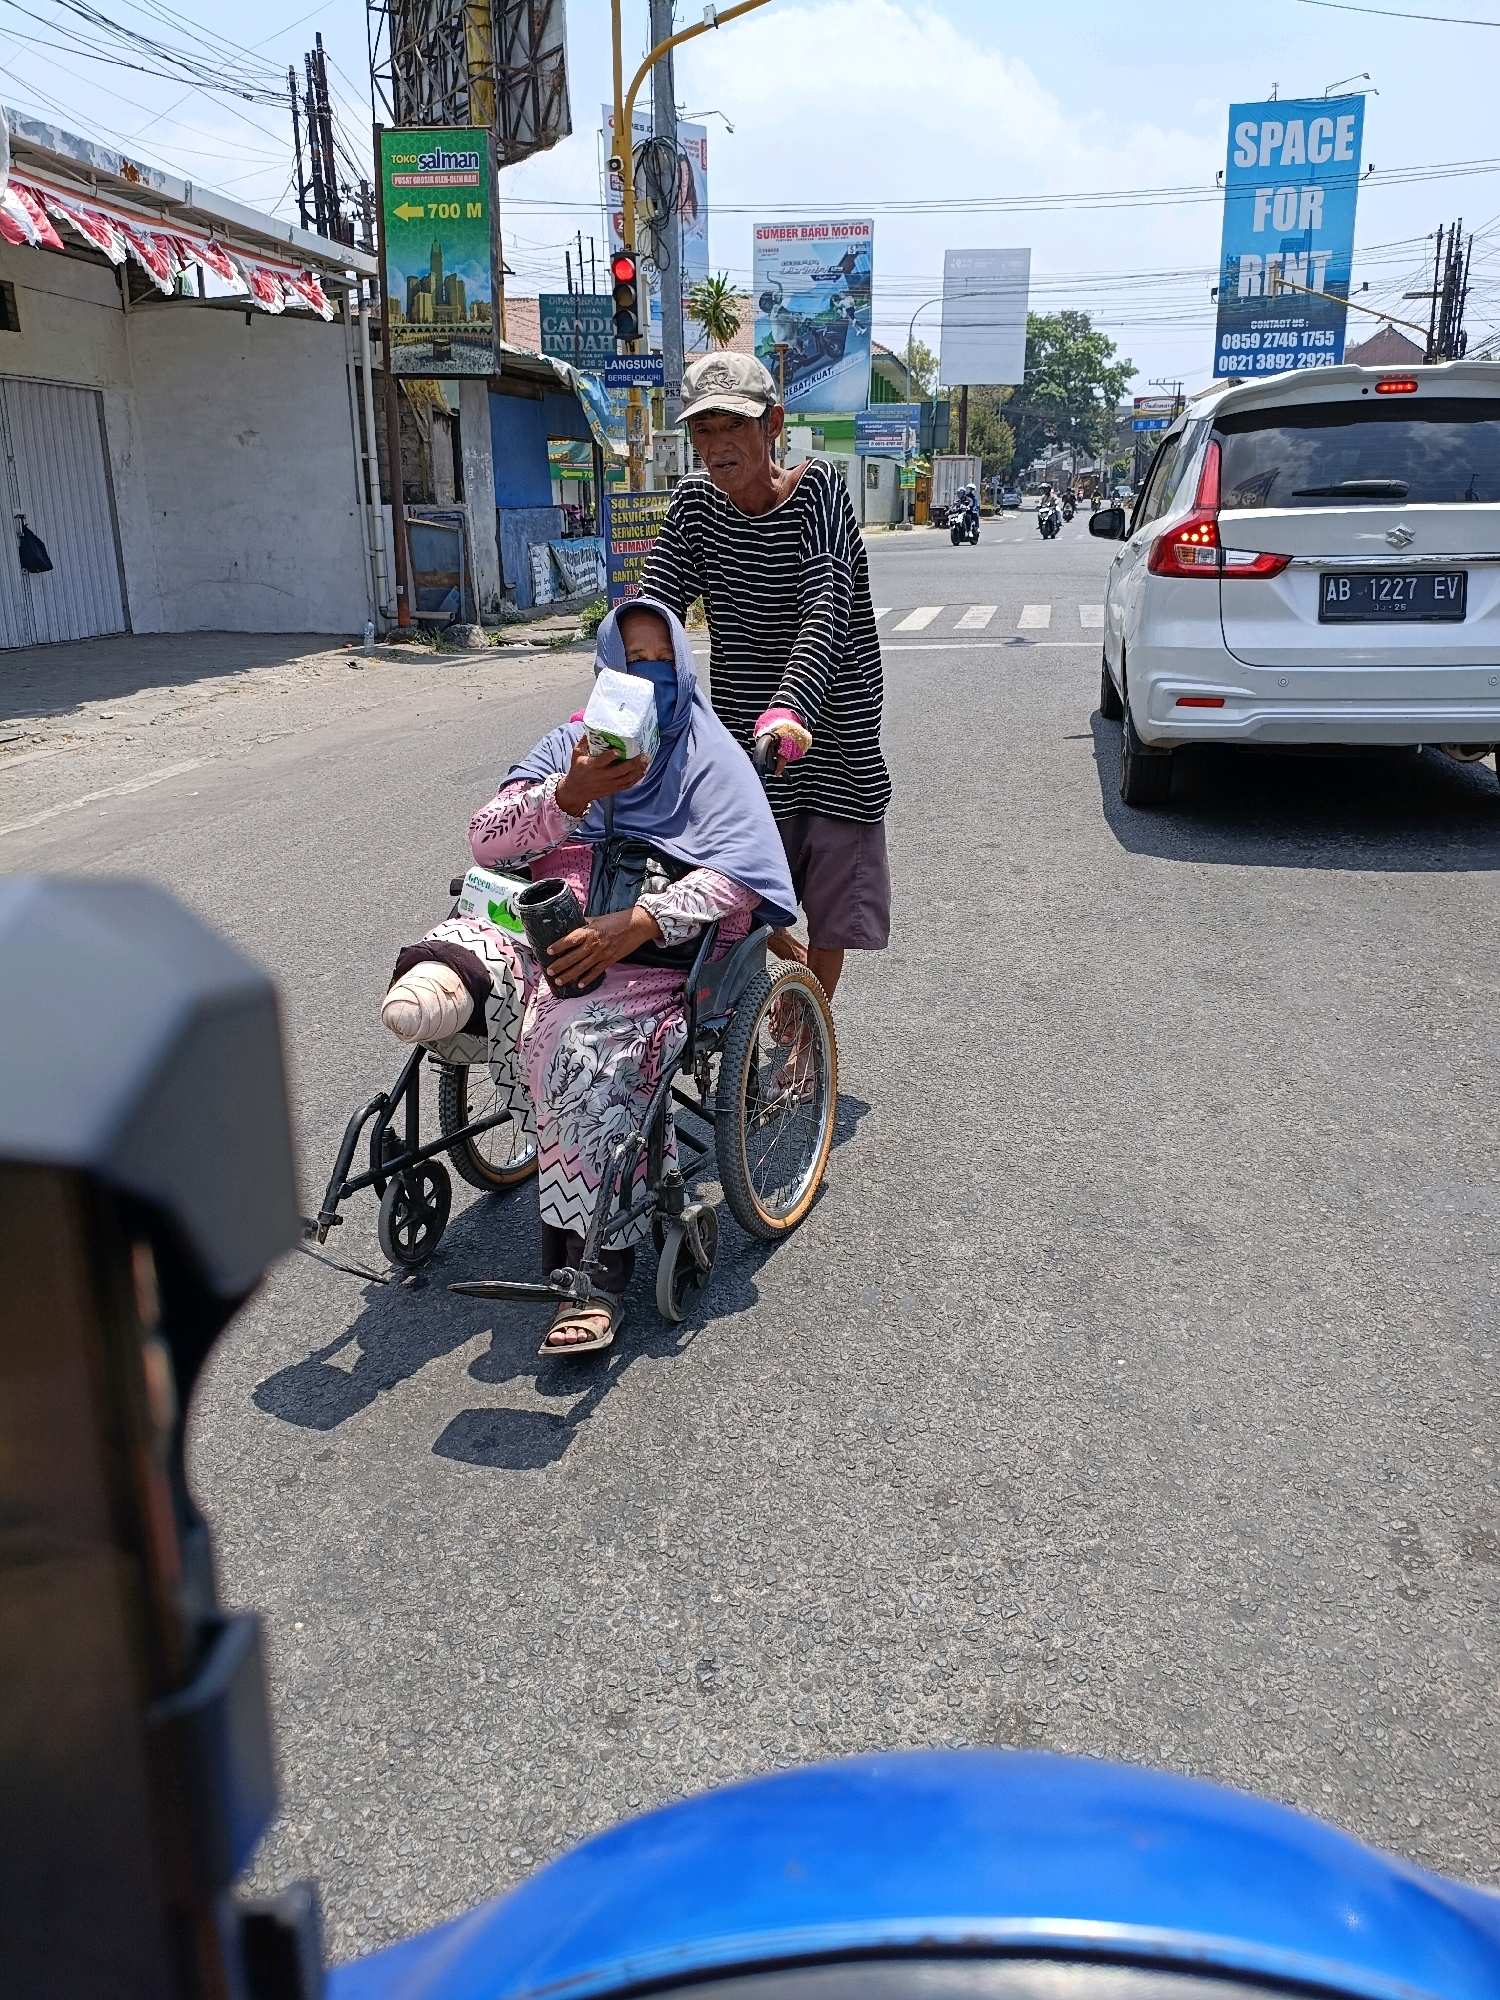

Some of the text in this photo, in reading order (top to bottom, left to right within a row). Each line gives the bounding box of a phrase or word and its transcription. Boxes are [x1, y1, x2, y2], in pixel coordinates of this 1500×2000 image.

[1233, 114, 1355, 168] SPACE
[391, 147, 479, 171] TOKO salman
[394, 174, 477, 184] PUSAT GROSIR OLEH-OLEH HAJI
[428, 202, 482, 218] 700 M
[1252, 185, 1324, 232] FOR
[756, 228, 798, 240] SUMBER
[801, 226, 829, 238] BARU
[832, 225, 870, 236] MOTOR
[1238, 250, 1332, 298] RENT
[542, 316, 613, 334] CANDI
[1250, 320, 1292, 330] CONTACT
[1292, 318, 1304, 328] US
[542, 334, 616, 352] INDAH
[1222, 330, 1335, 350] 0859 2746 1755
[604, 359, 664, 370] LANGSUNG
[1218, 352, 1335, 372] 0821 3892 2925
[608, 374, 646, 382] BERBELOK
[784, 367, 834, 398] HEBAT, KUAT,
[611, 496, 670, 510] SOL SEPATU
[611, 510, 650, 524] SERVICE
[612, 526, 645, 539] SERVICE
[611, 540, 648, 554] VERMAK
[624, 558, 638, 568] CAT
[612, 570, 632, 582] GANTI
[1326, 576, 1458, 601] AB 1227 EV
